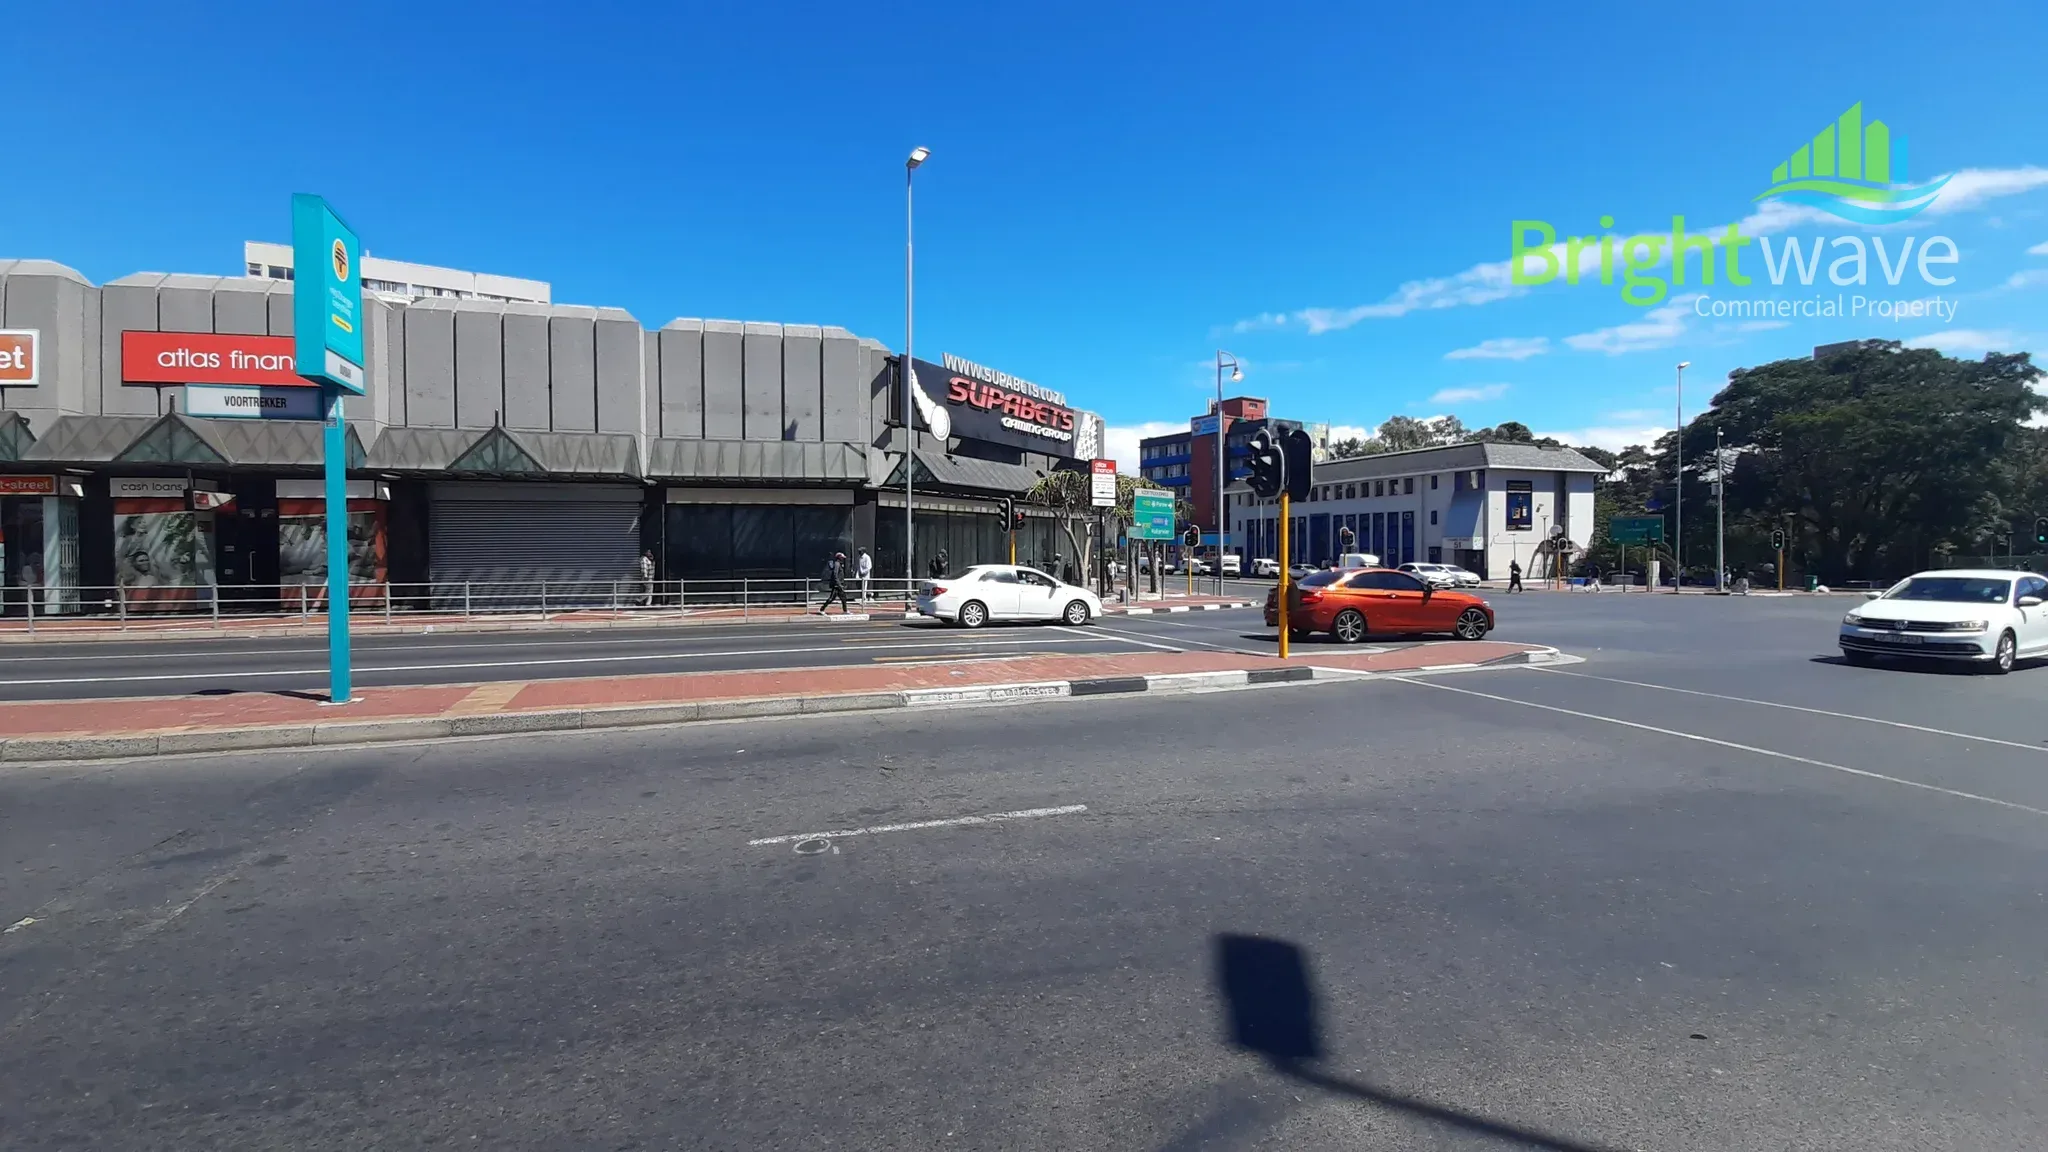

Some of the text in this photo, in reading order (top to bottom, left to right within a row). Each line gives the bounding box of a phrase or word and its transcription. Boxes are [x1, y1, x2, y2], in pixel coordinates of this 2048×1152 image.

[157, 348, 297, 371] atlas finan
[224, 396, 287, 409] VOORTREKKER
[947, 377, 1075, 431] SUPABETS
[1001, 417, 1072, 442] GAMING GROUP
[121, 481, 183, 492] cash loans
